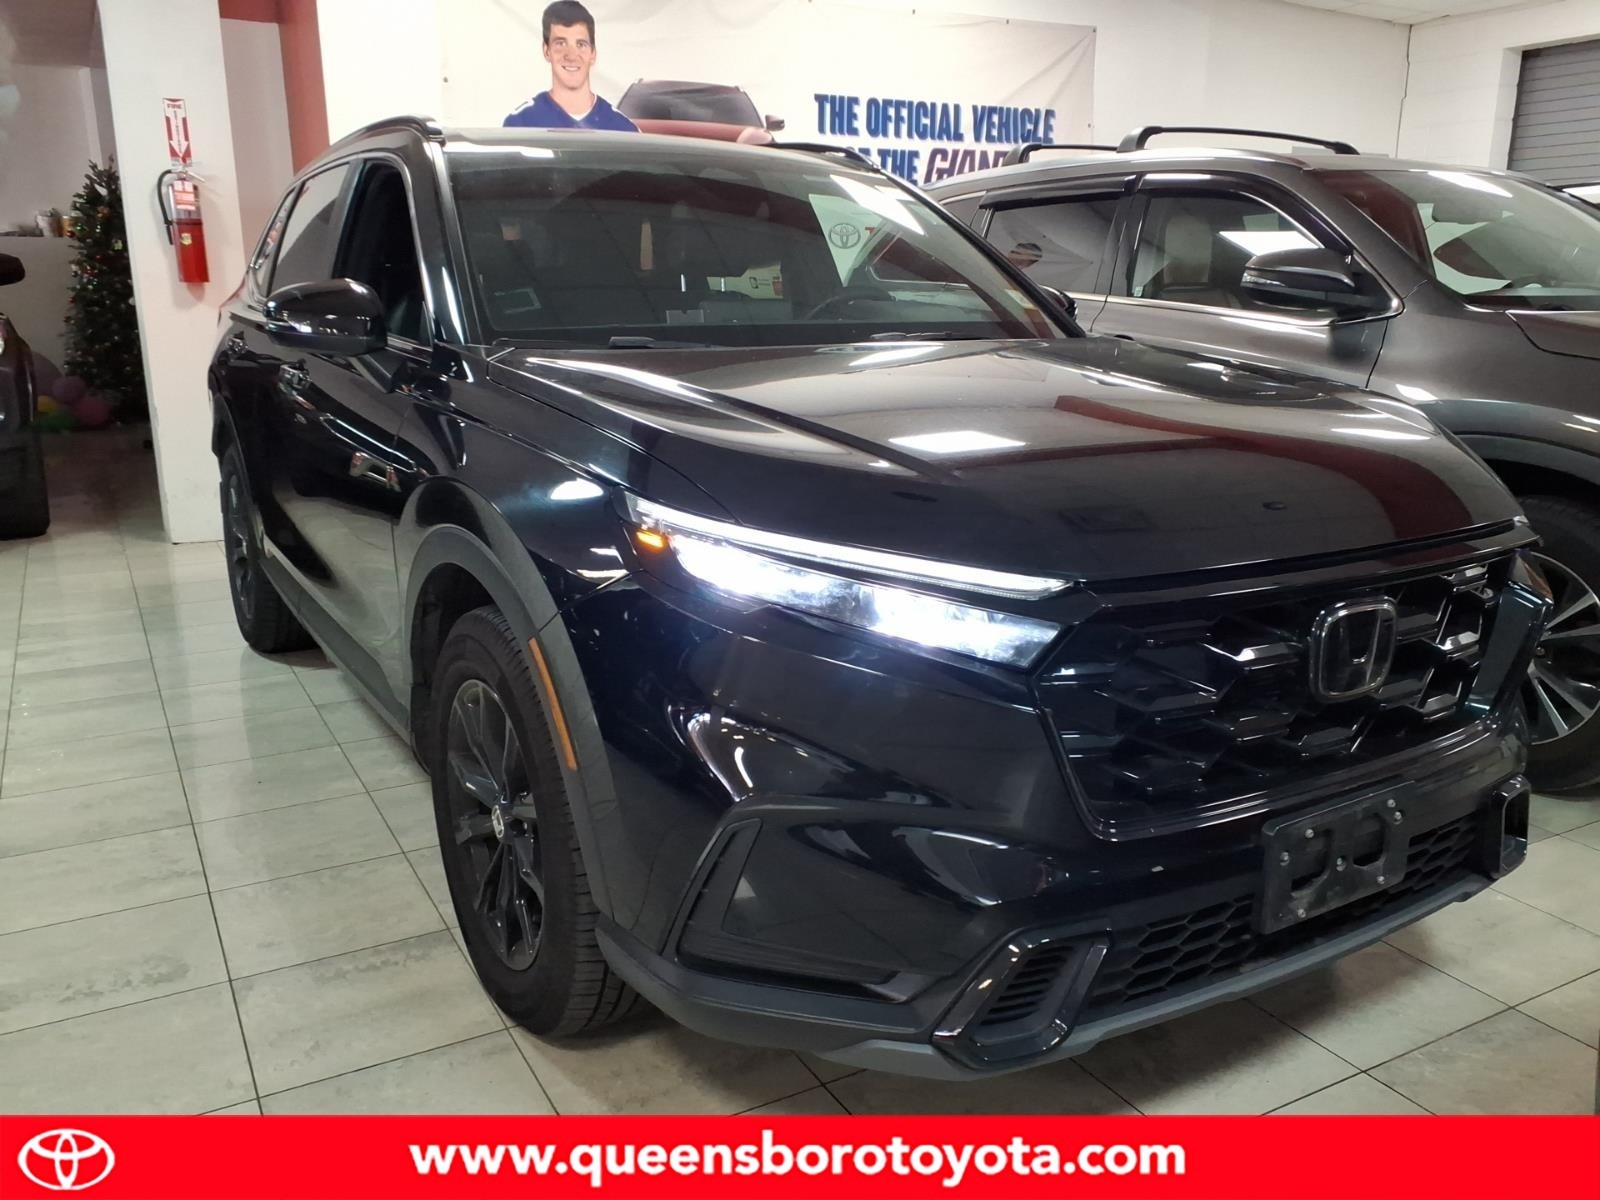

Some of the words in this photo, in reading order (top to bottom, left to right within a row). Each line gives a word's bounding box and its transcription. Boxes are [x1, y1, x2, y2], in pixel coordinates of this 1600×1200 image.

[814, 93, 860, 137] THE
[865, 97, 965, 143] OFFICIAL
[971, 104, 1056, 145] VEHICLE
[877, 148, 920, 186] THE
[923, 147, 1009, 185] GIAN
